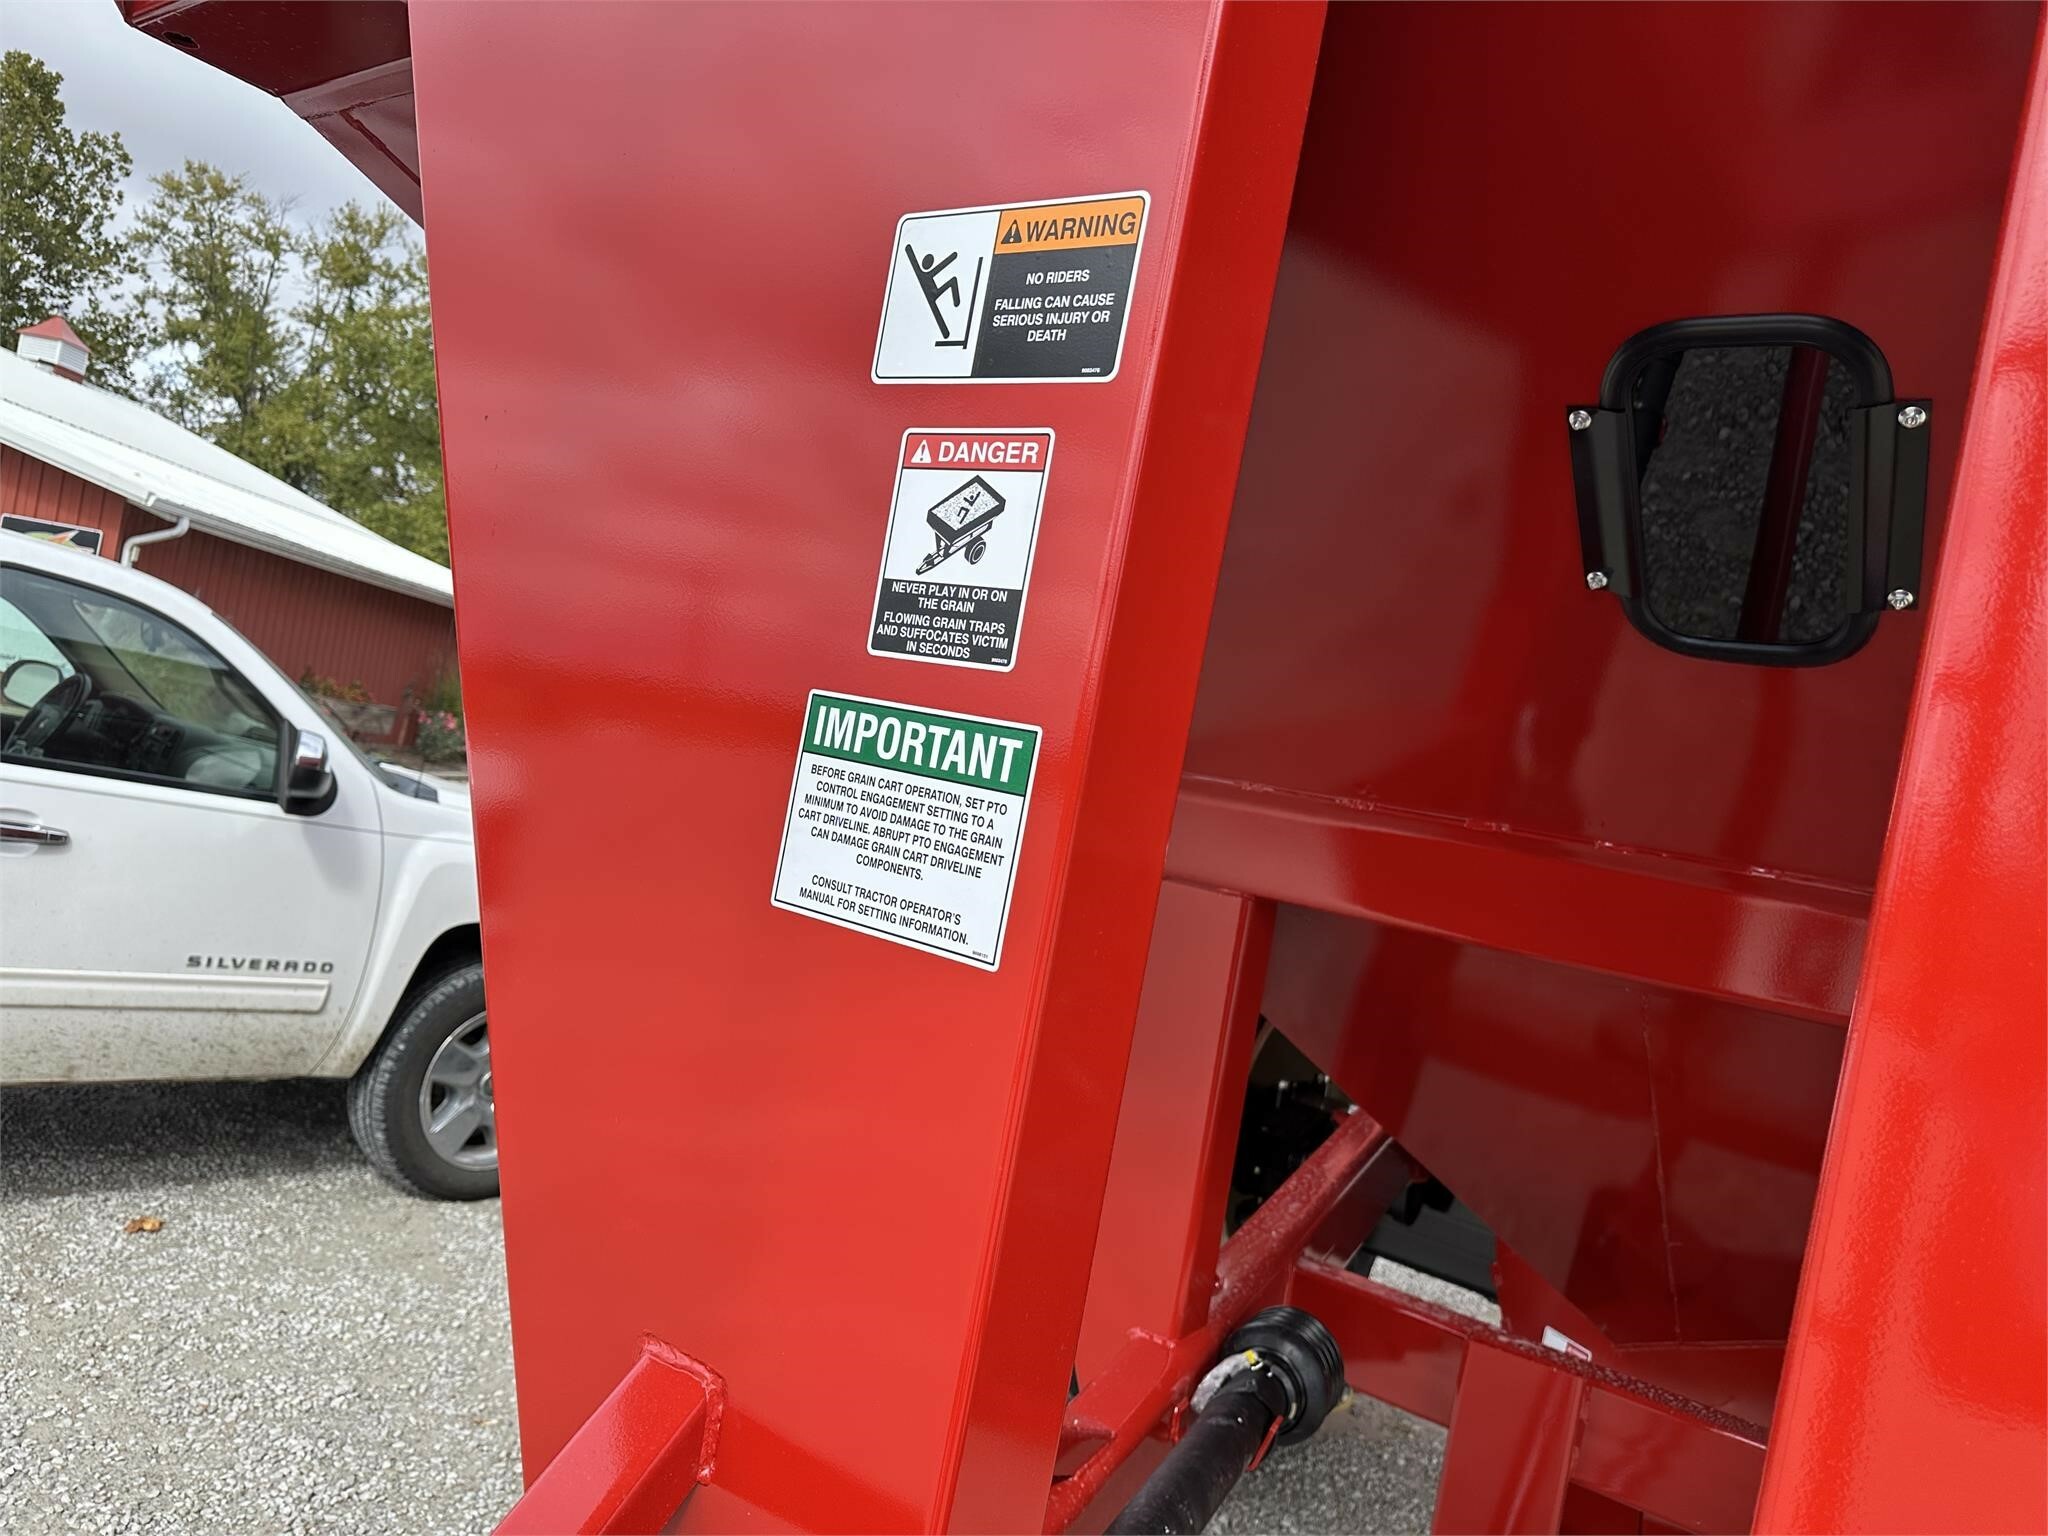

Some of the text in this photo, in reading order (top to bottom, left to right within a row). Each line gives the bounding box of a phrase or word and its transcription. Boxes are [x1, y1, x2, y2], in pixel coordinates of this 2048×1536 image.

[1026, 211, 1137, 242] WARNING
[1025, 269, 1090, 285] NO RIDERS
[994, 293, 1115, 311] FALLING CAN CAUSE
[992, 310, 1111, 327] SERIOUS INJURY OR
[1026, 329, 1067, 342] DEATH
[938, 441, 1039, 464] DANGER
[892, 581, 1008, 602] NEVER PLAY IN OR ON
[918, 597, 975, 613] THE GRAIN
[883, 611, 1006, 635] FLOWING GRAIN TRAPS
[876, 624, 1009, 649] AND SUFFOCATES VICTIM
[906, 641, 971, 659] IN SECONDS
[812, 705, 1023, 783] IMPORTANT
[810, 764, 1008, 816] BEFORE GRAIN CART OPERATION, SET PTO
[816, 780, 994, 830] CONTROL ENGAGEMENT SETTING TO A
[804, 793, 1003, 849] MINIMUM TO AVOID DAMAGE TO THE GRAIN
[798, 807, 1005, 867] CART DRIVELINE. ABRUPT PTO ENGAGEMENT
[810, 826, 983, 879] CAN DAMAGE GRAIN CART DRIVELINE
[855, 853, 924, 881] COMPONENTS.
[811, 874, 962, 926] CONSULT TRACTOR OPERATOR'S
[799, 887, 969, 945] MANUAL FOR SETTING INFORMATION.
[186, 955, 334, 974] SILVERADO
